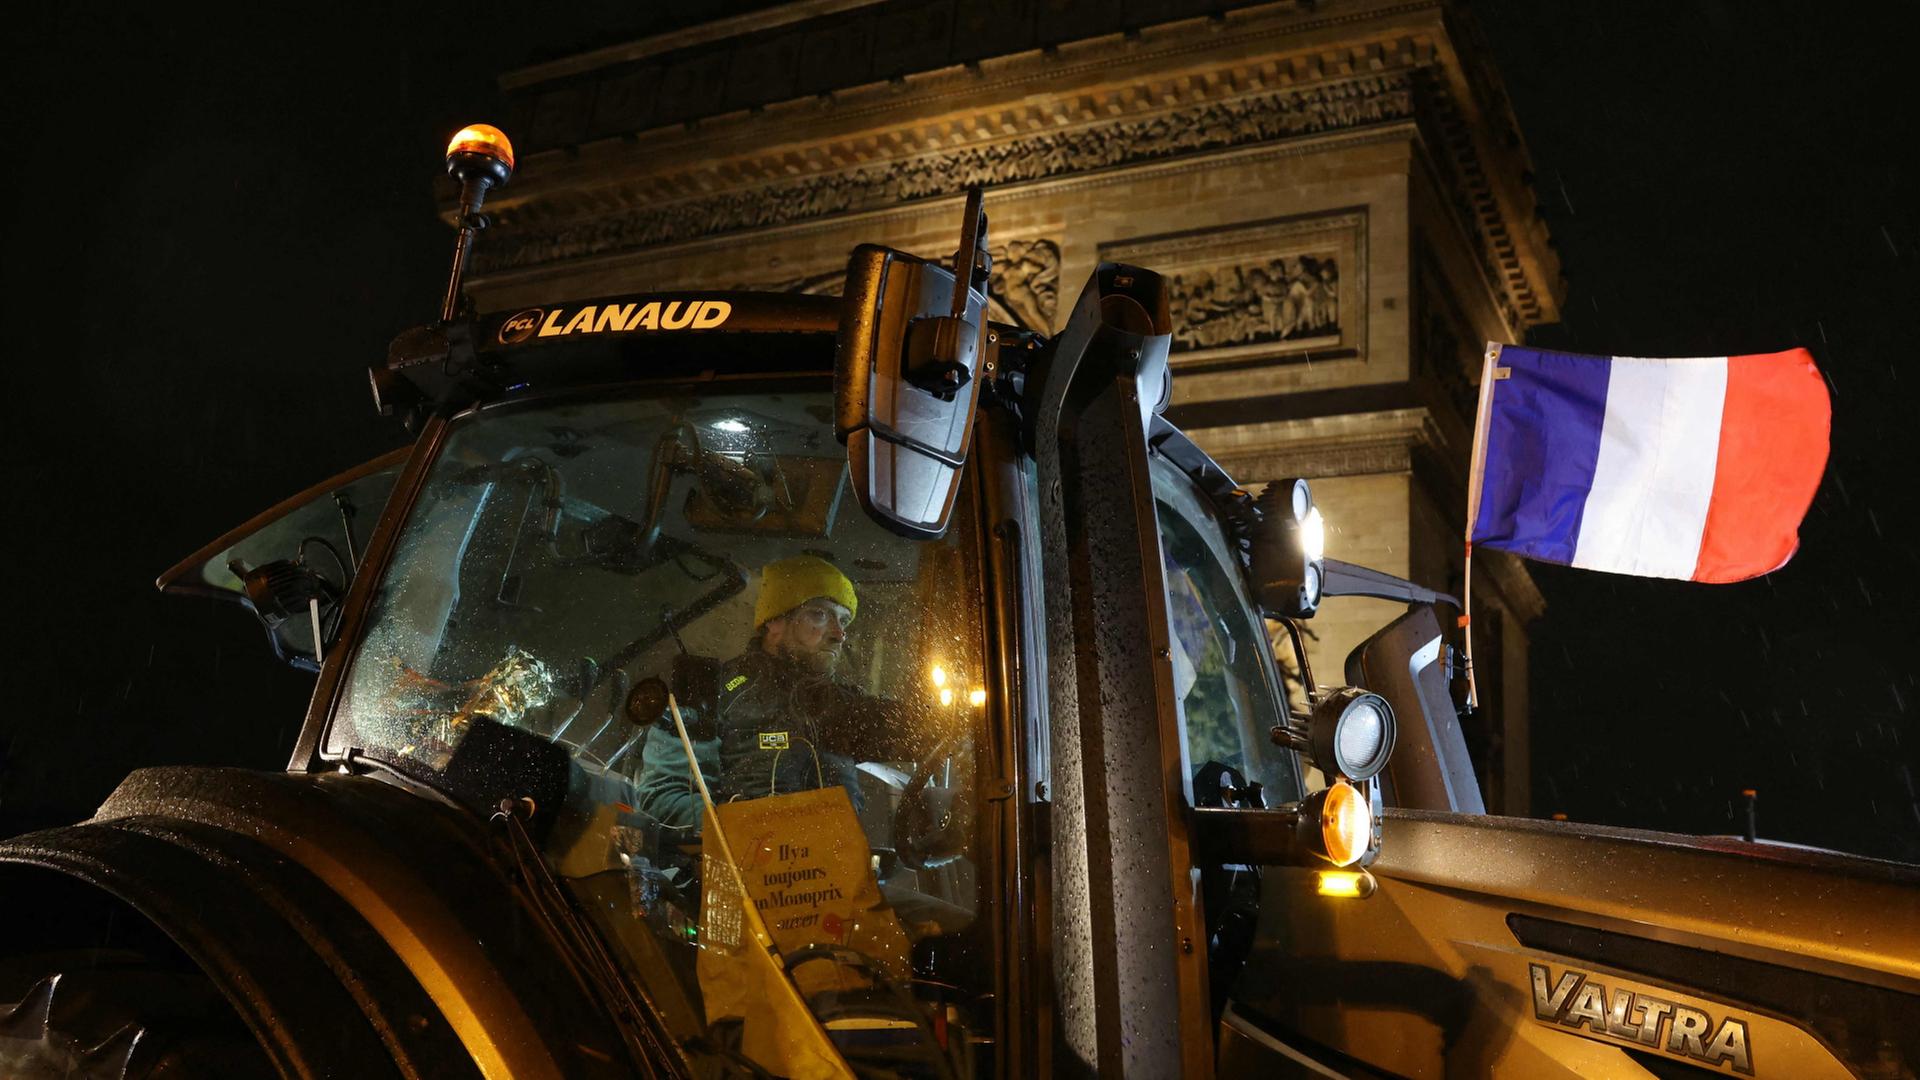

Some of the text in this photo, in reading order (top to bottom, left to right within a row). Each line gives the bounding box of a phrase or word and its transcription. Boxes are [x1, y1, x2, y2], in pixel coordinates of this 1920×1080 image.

[504, 301, 732, 337] PCL LANAUD
[762, 734, 786, 743] JCB
[791, 849, 800, 865] y
[801, 847, 809, 858] a
[764, 866, 826, 888] toujours
[769, 884, 842, 909] Monoprix
[1529, 962, 1755, 1077] VALTRA
